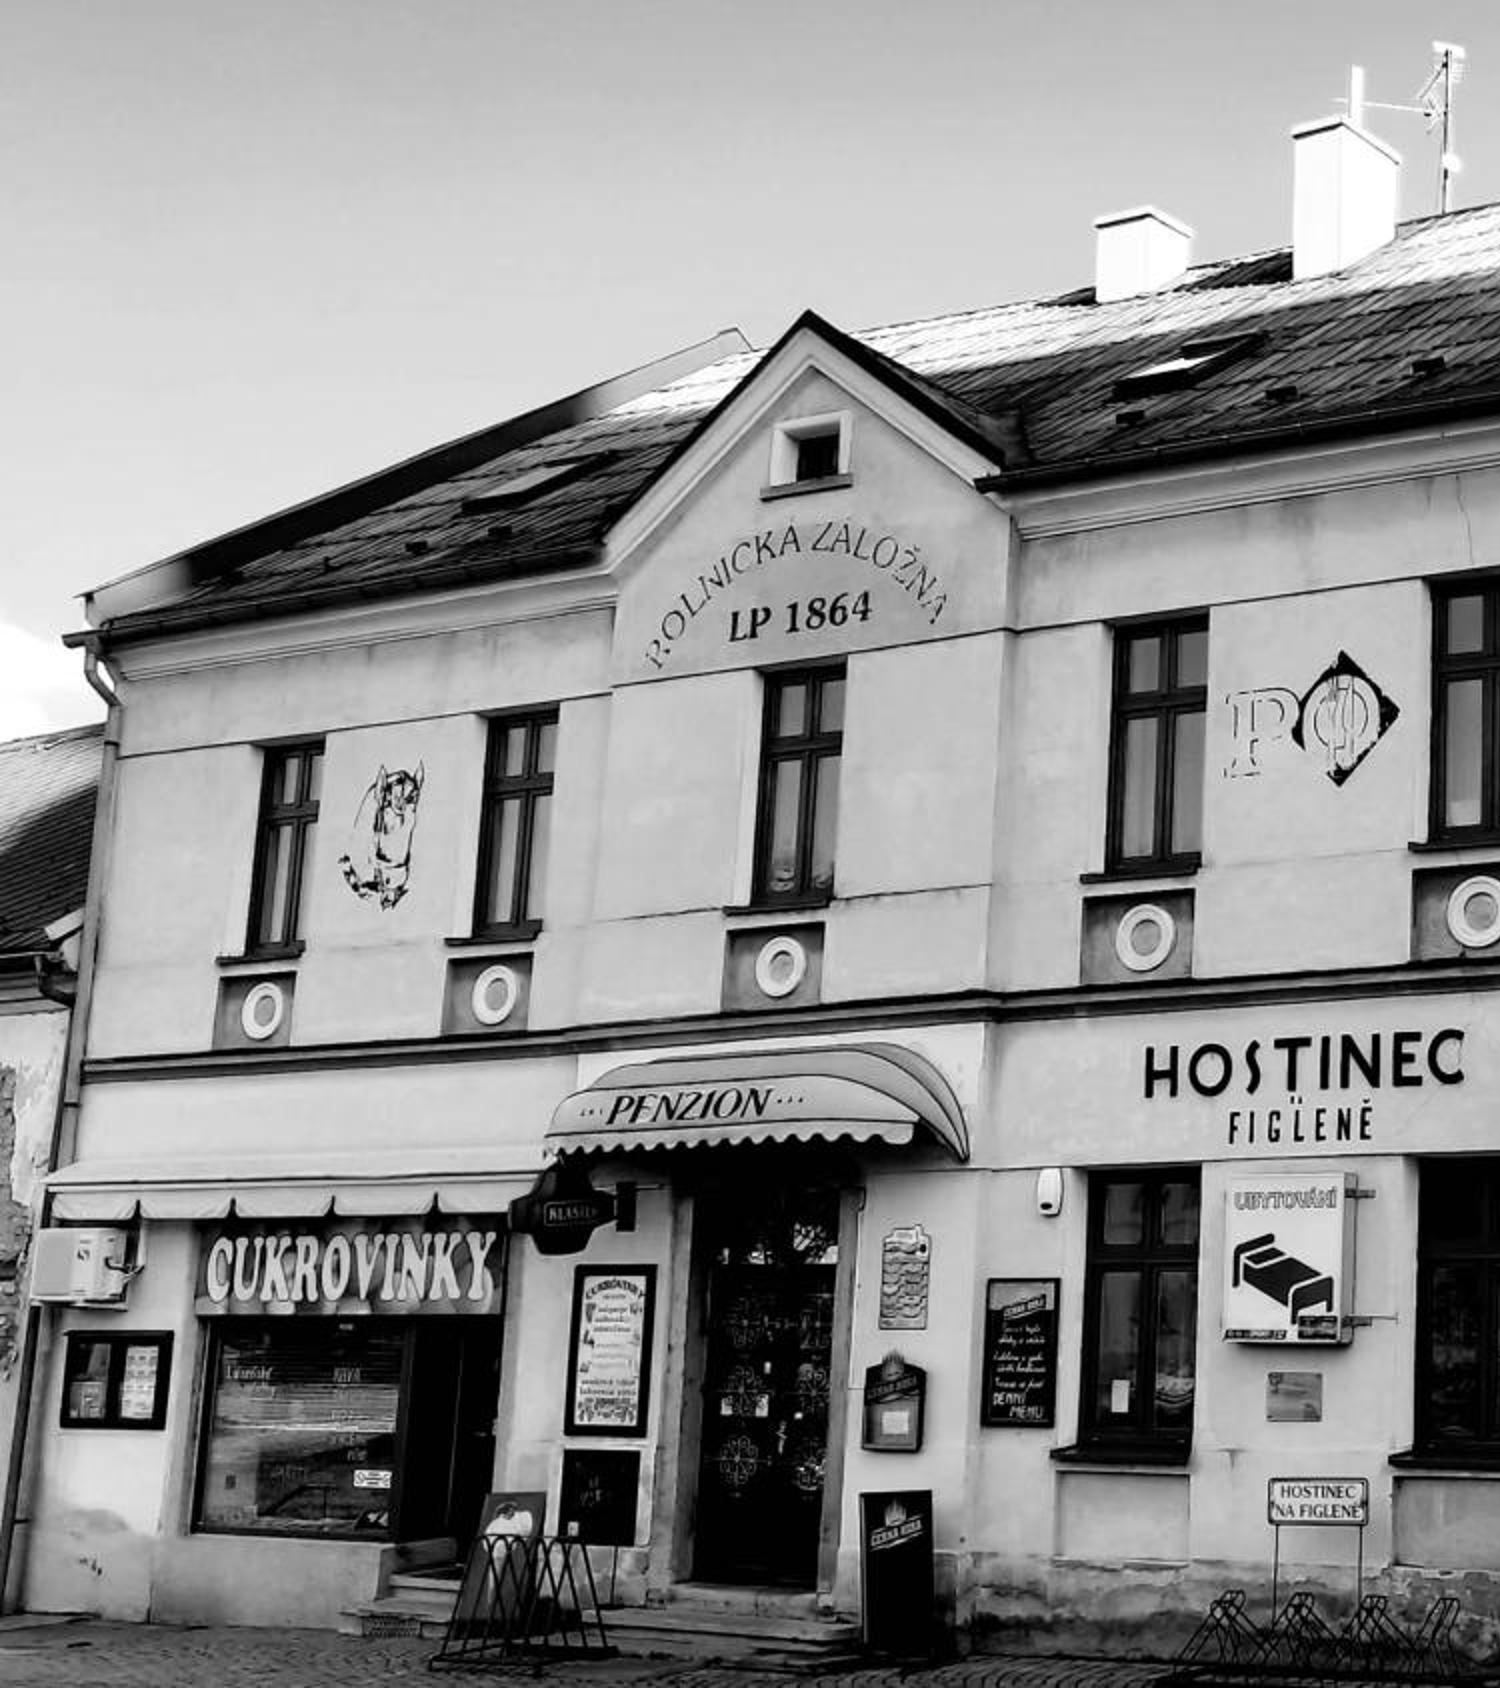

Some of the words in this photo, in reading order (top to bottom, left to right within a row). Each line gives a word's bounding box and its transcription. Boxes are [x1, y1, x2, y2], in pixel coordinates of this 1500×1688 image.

[727, 606, 773, 643] LP
[783, 589, 874, 634] 1864
[1144, 1028, 1466, 1099] HOSTINEC
[207, 1231, 498, 1303] CUKROVINKY
[1275, 1502, 1296, 1518] NA
[1280, 1484, 1358, 1500] HOSTINEC
